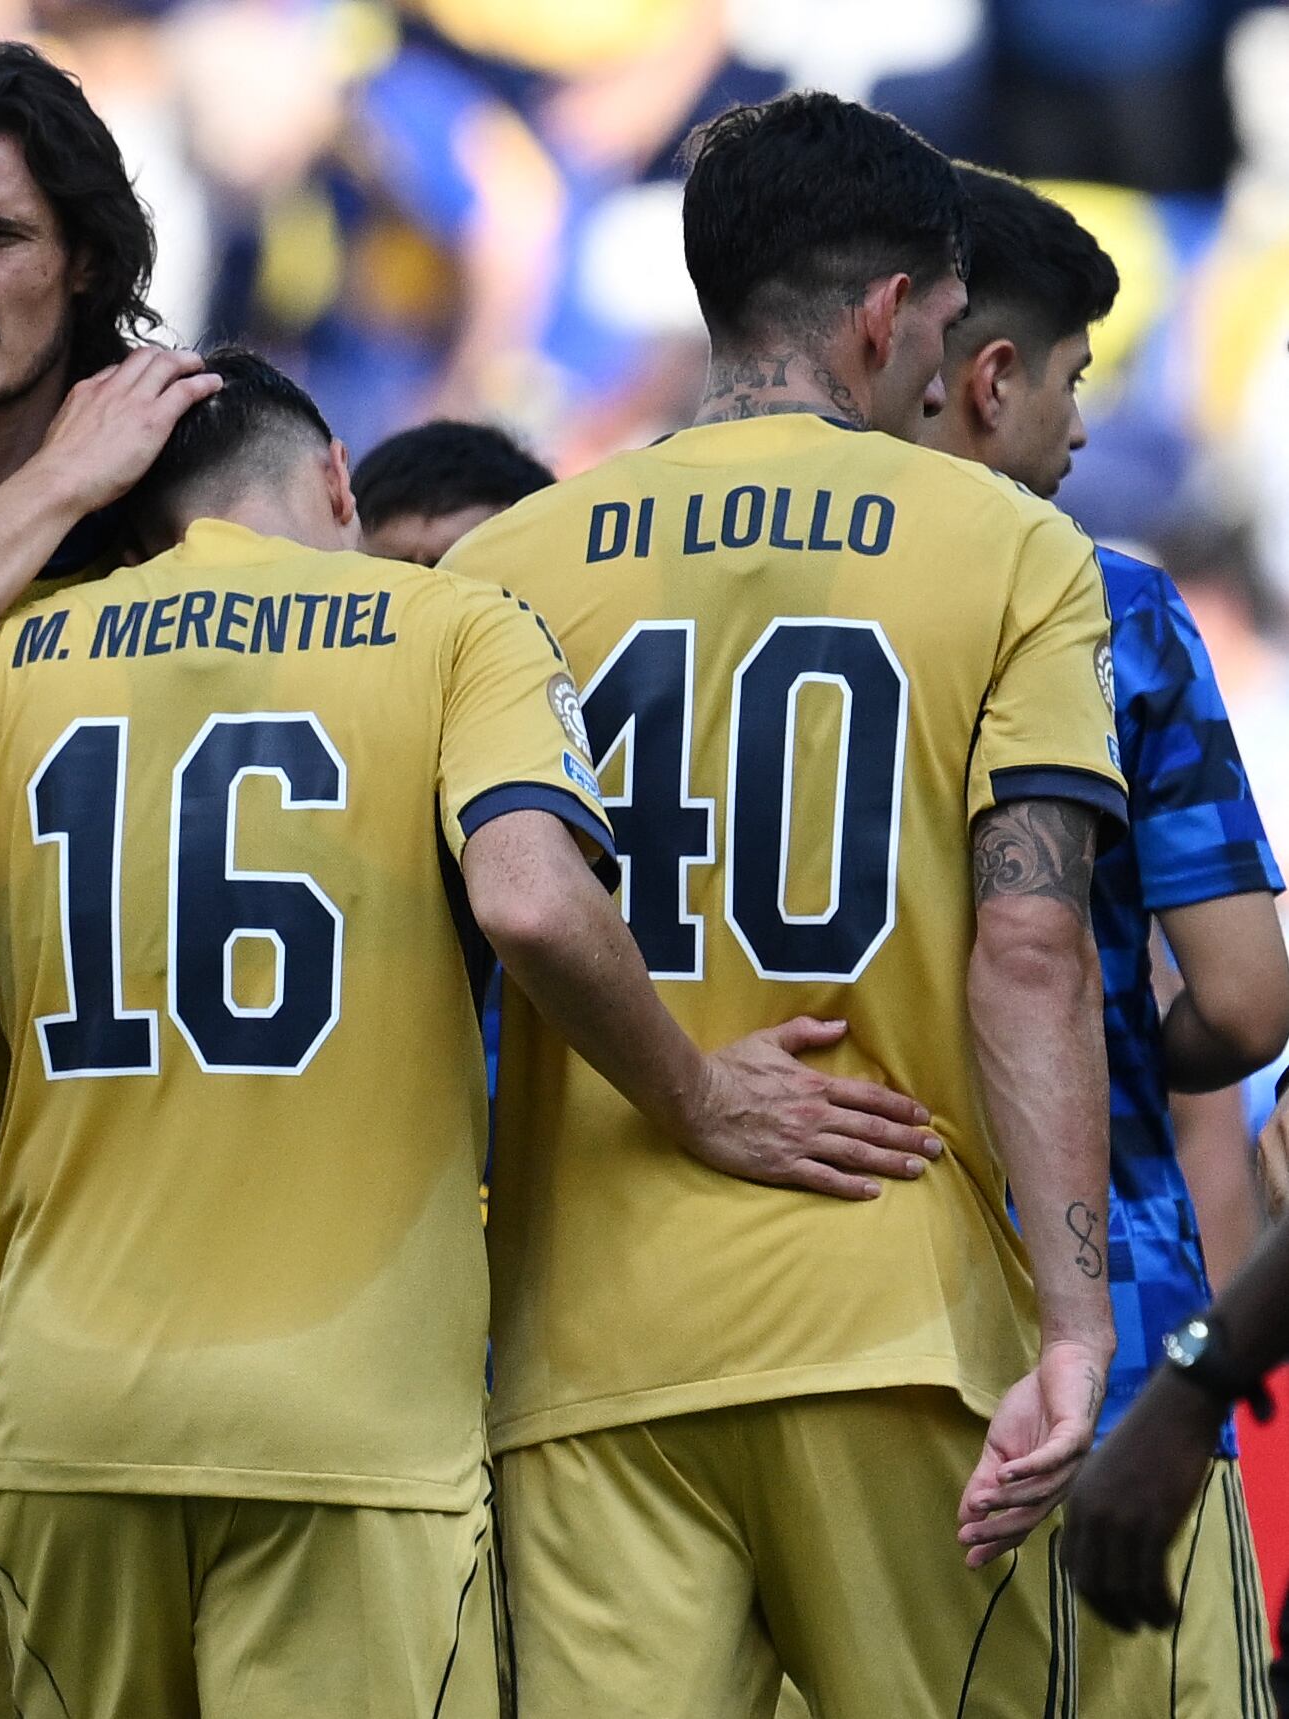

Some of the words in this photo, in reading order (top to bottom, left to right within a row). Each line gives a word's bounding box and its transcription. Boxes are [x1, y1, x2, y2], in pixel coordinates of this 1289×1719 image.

[11, 609, 71, 669] M.
[89, 590, 397, 660] MERENTIEL
[586, 497, 655, 563] DI
[683, 485, 896, 556] LOLLO
[27, 711, 347, 1080] 16
[578, 617, 909, 983] 40
